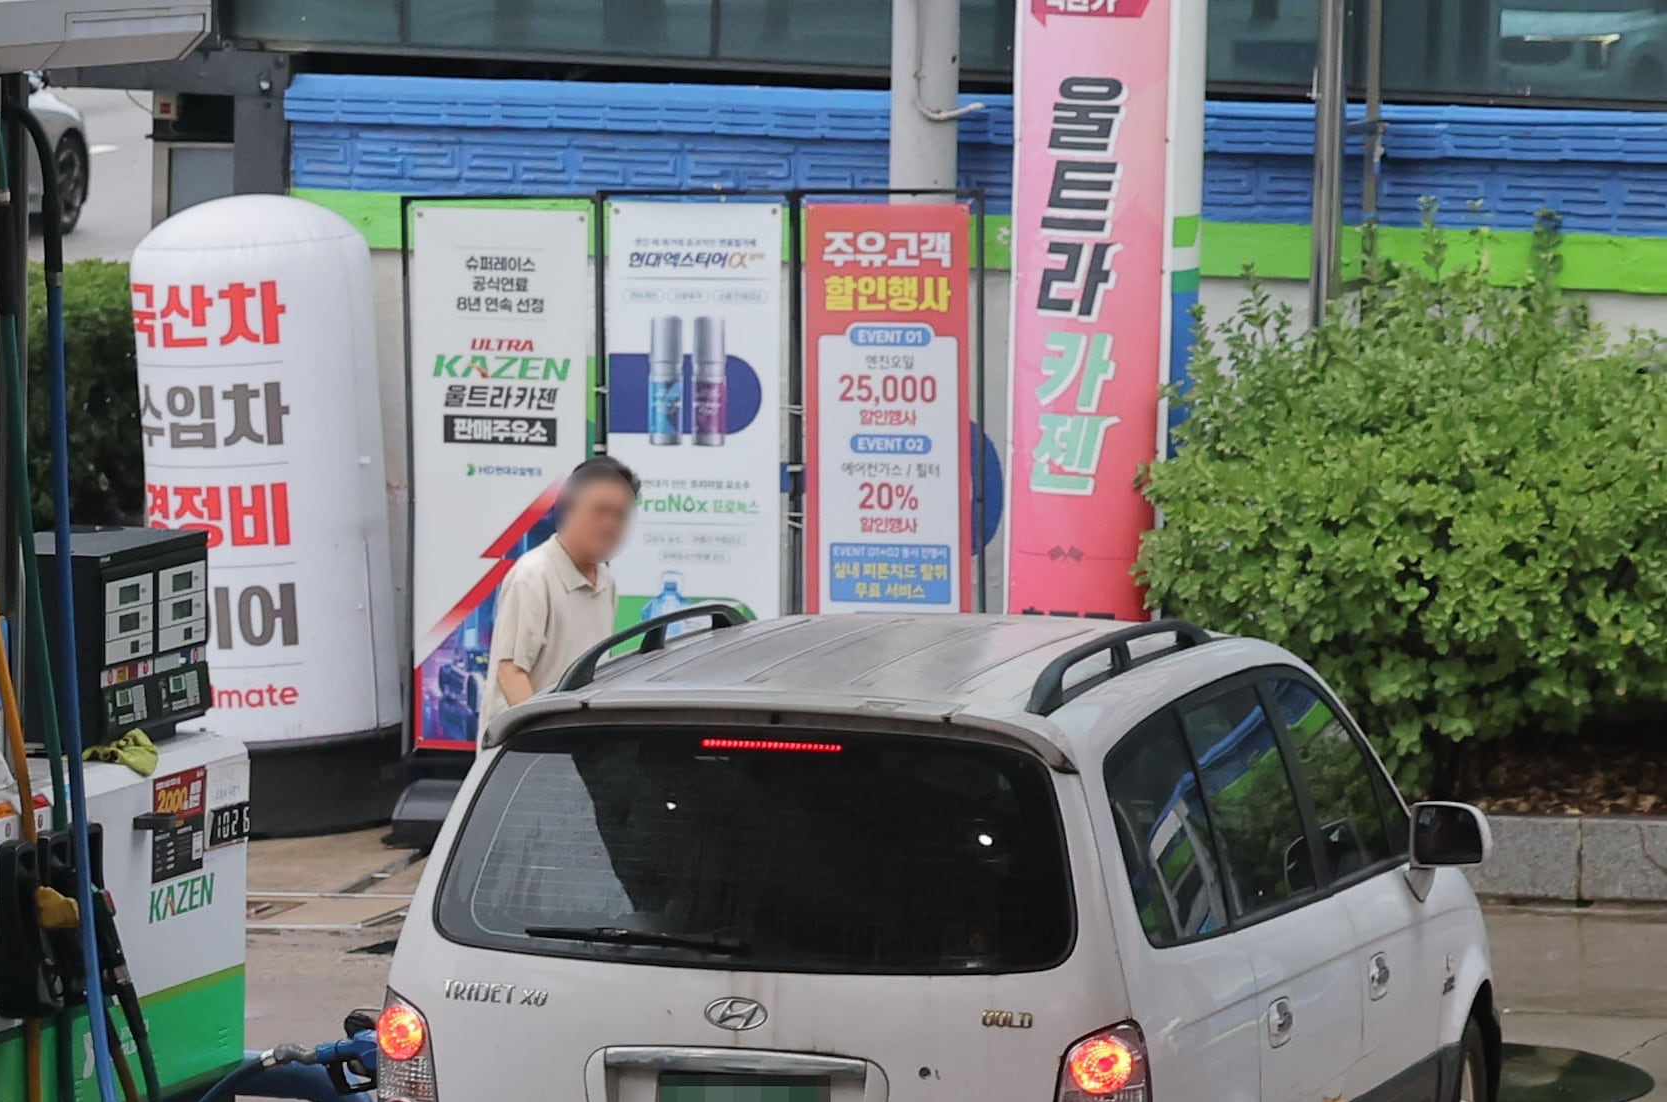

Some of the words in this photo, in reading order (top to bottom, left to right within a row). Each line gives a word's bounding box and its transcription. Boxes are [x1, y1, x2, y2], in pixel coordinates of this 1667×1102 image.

[822, 230, 952, 268] 주유고객
[465, 255, 536, 273] 슈퍼레이스
[472, 275, 529, 293] 공식연료
[824, 274, 953, 313] 할인행사
[456, 296, 482, 313] 8년
[484, 297, 513, 314] 연속
[516, 298, 545, 314] 선정
[470, 337, 535, 353] ULTRA
[857, 329, 904, 344] EVENT
[905, 329, 923, 344] 01
[432, 353, 572, 382] KAZEN
[865, 354, 915, 371] 엔진오일
[838, 373, 938, 407] 25,000
[859, 408, 917, 427] 할인행사
[856, 436, 903, 451] EVENT
[904, 437, 925, 452] 02
[858, 481, 919, 511] 20%
[147, 482, 292, 550] 정비
[859, 516, 918, 534] 할인행사
[885, 582, 926, 600] 서비스
[212, 682, 300, 709] mate
[147, 871, 216, 926] KAZEN
[442, 978, 517, 1004] TRAJET
[981, 1008, 1034, 1029] GOLD
